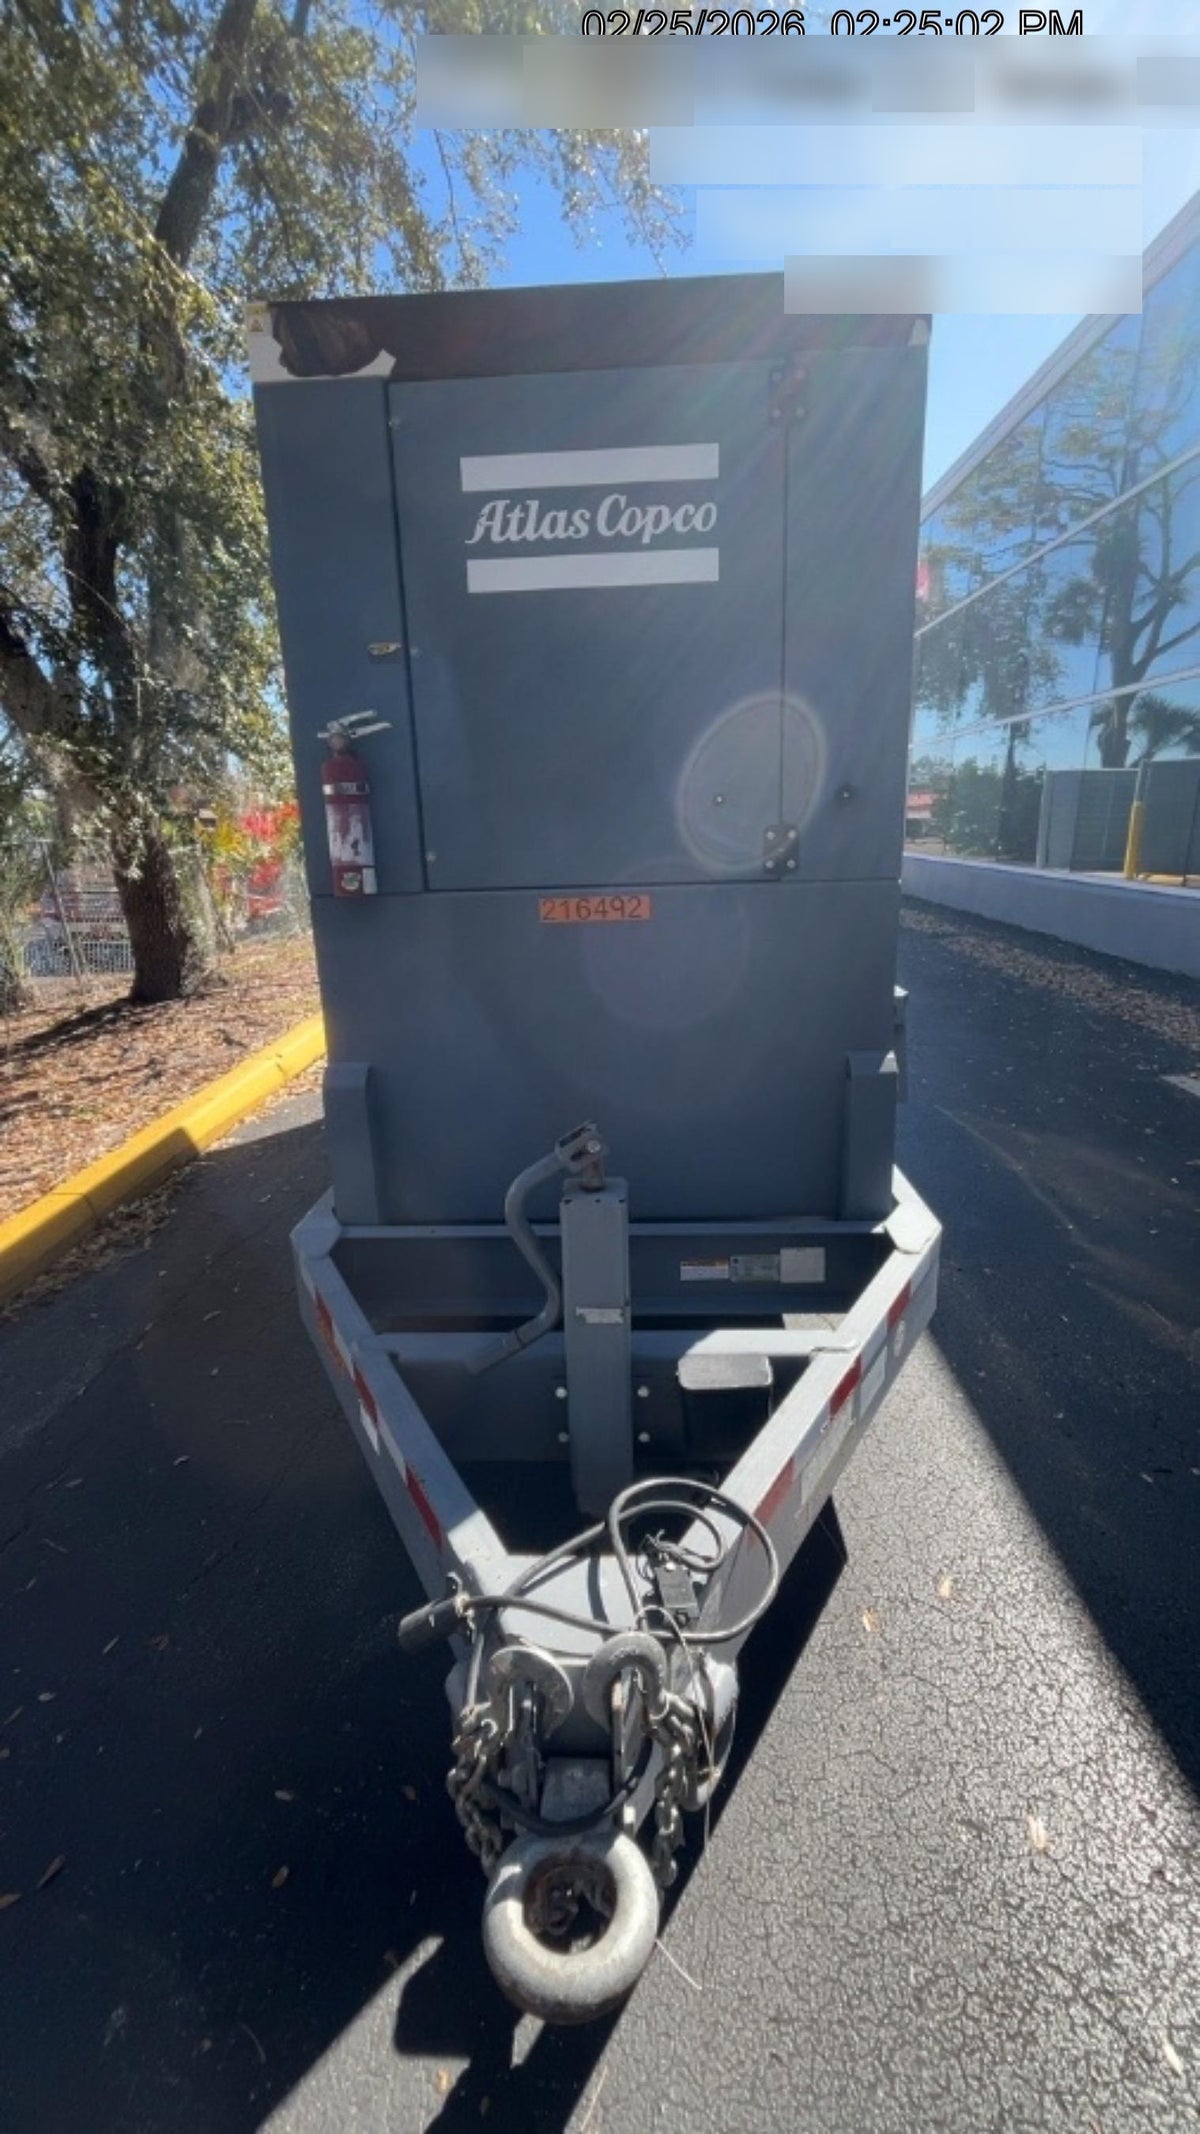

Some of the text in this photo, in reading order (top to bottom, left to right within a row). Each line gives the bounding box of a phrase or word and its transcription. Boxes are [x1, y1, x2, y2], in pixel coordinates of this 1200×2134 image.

[464, 493, 718, 544] Atlas Copco
[542, 896, 643, 920] 216492
